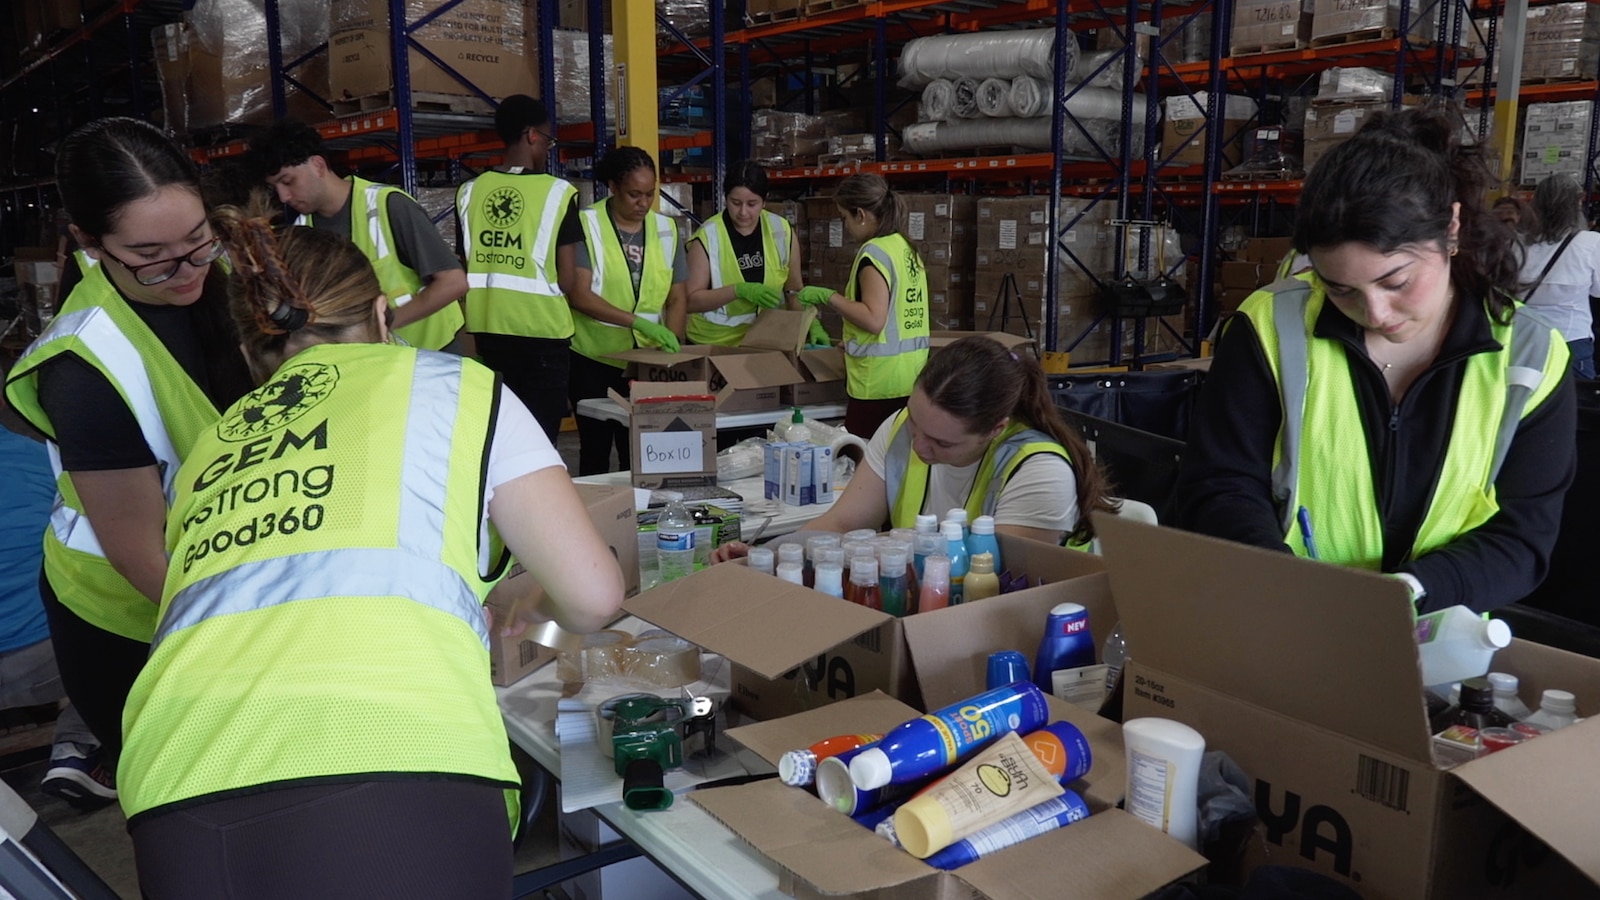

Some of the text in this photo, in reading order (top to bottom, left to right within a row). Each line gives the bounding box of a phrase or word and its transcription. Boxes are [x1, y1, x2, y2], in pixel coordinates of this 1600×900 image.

[486, 15, 501, 23] CUT
[465, 53, 500, 64] RECYCLE
[479, 229, 523, 251] GEM
[475, 249, 526, 270] bstrong
[192, 417, 329, 493] GEM
[183, 503, 325, 574] Good360
[1066, 619, 1086, 633] NEW
[948, 712, 973, 745] SPORT
[958, 705, 991, 742] 50
[970, 782, 983, 794] 70
[1254, 777, 1354, 879] YA
